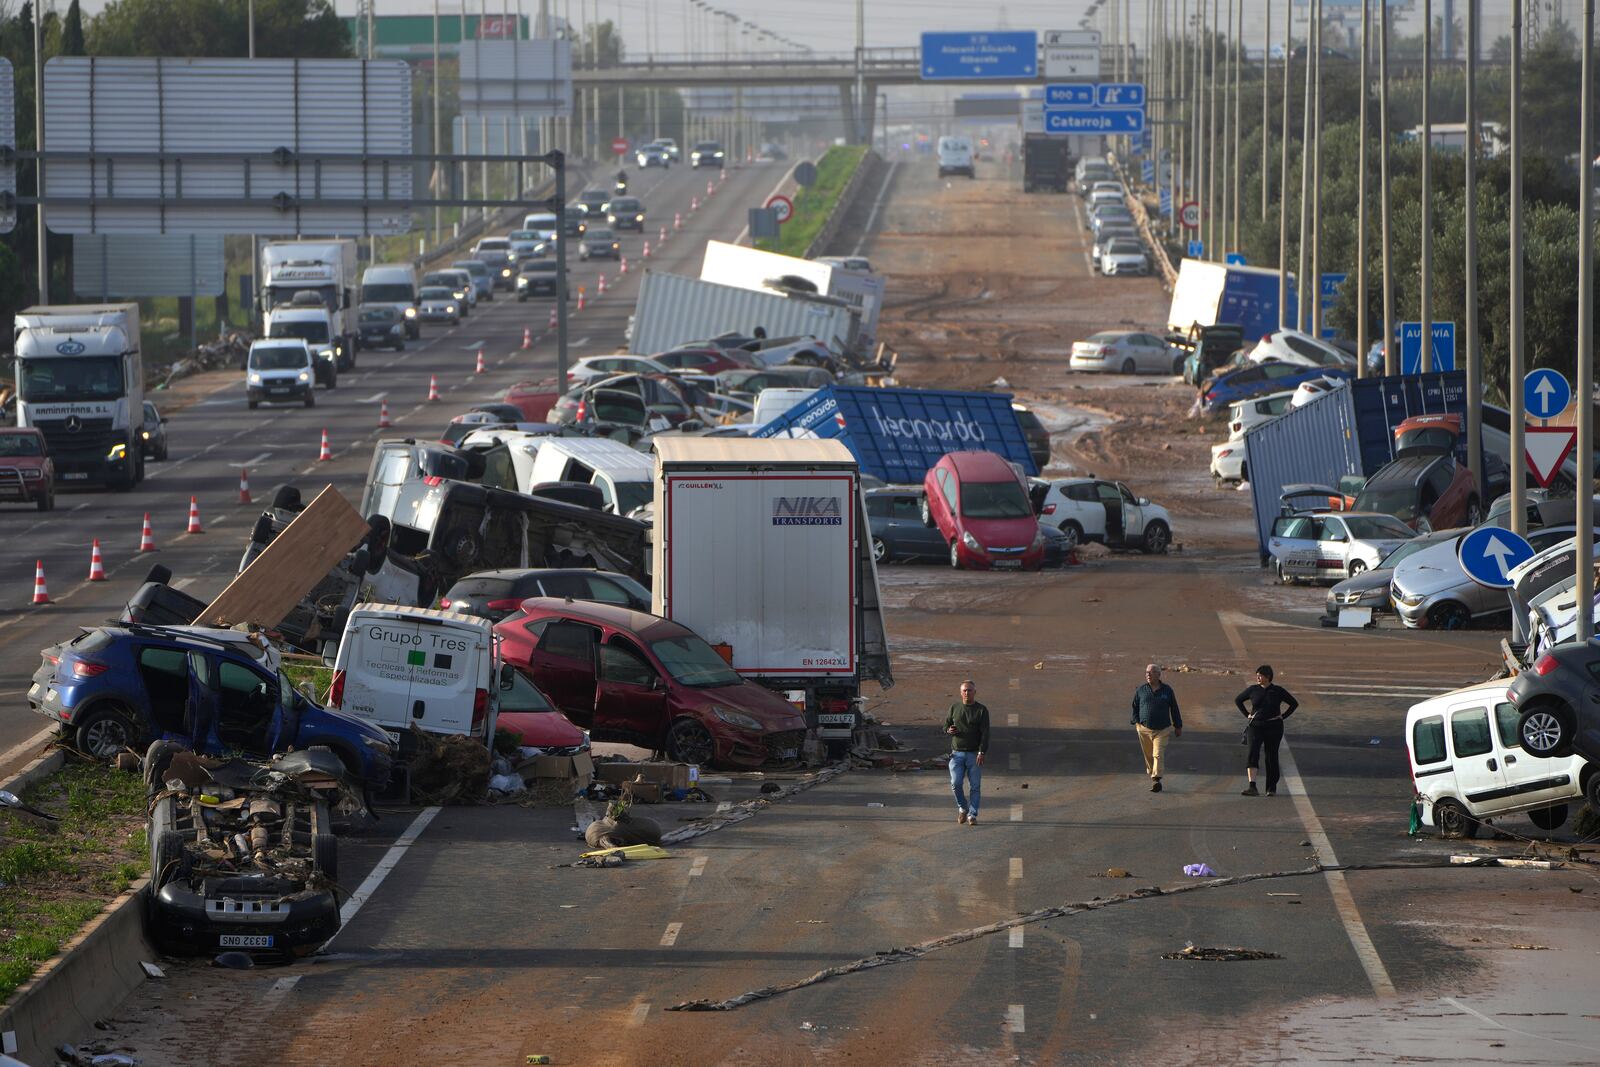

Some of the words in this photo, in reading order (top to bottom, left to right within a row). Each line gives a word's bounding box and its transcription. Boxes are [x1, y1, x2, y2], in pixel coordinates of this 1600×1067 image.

[1051, 90, 1073, 100] 500
[1078, 92, 1089, 100] m
[1051, 116, 1112, 129] Catarroja
[776, 496, 840, 516] NIKA
[776, 517, 841, 525] TRANSPORTS
[369, 626, 422, 646] Grupo
[430, 633, 467, 652] Tres
[802, 658, 813, 666] EN
[366, 660, 405, 673] Tecnicas
[416, 667, 460, 680] Reformas
[222, 936, 241, 945] GNS
[243, 936, 268, 946] 6332
